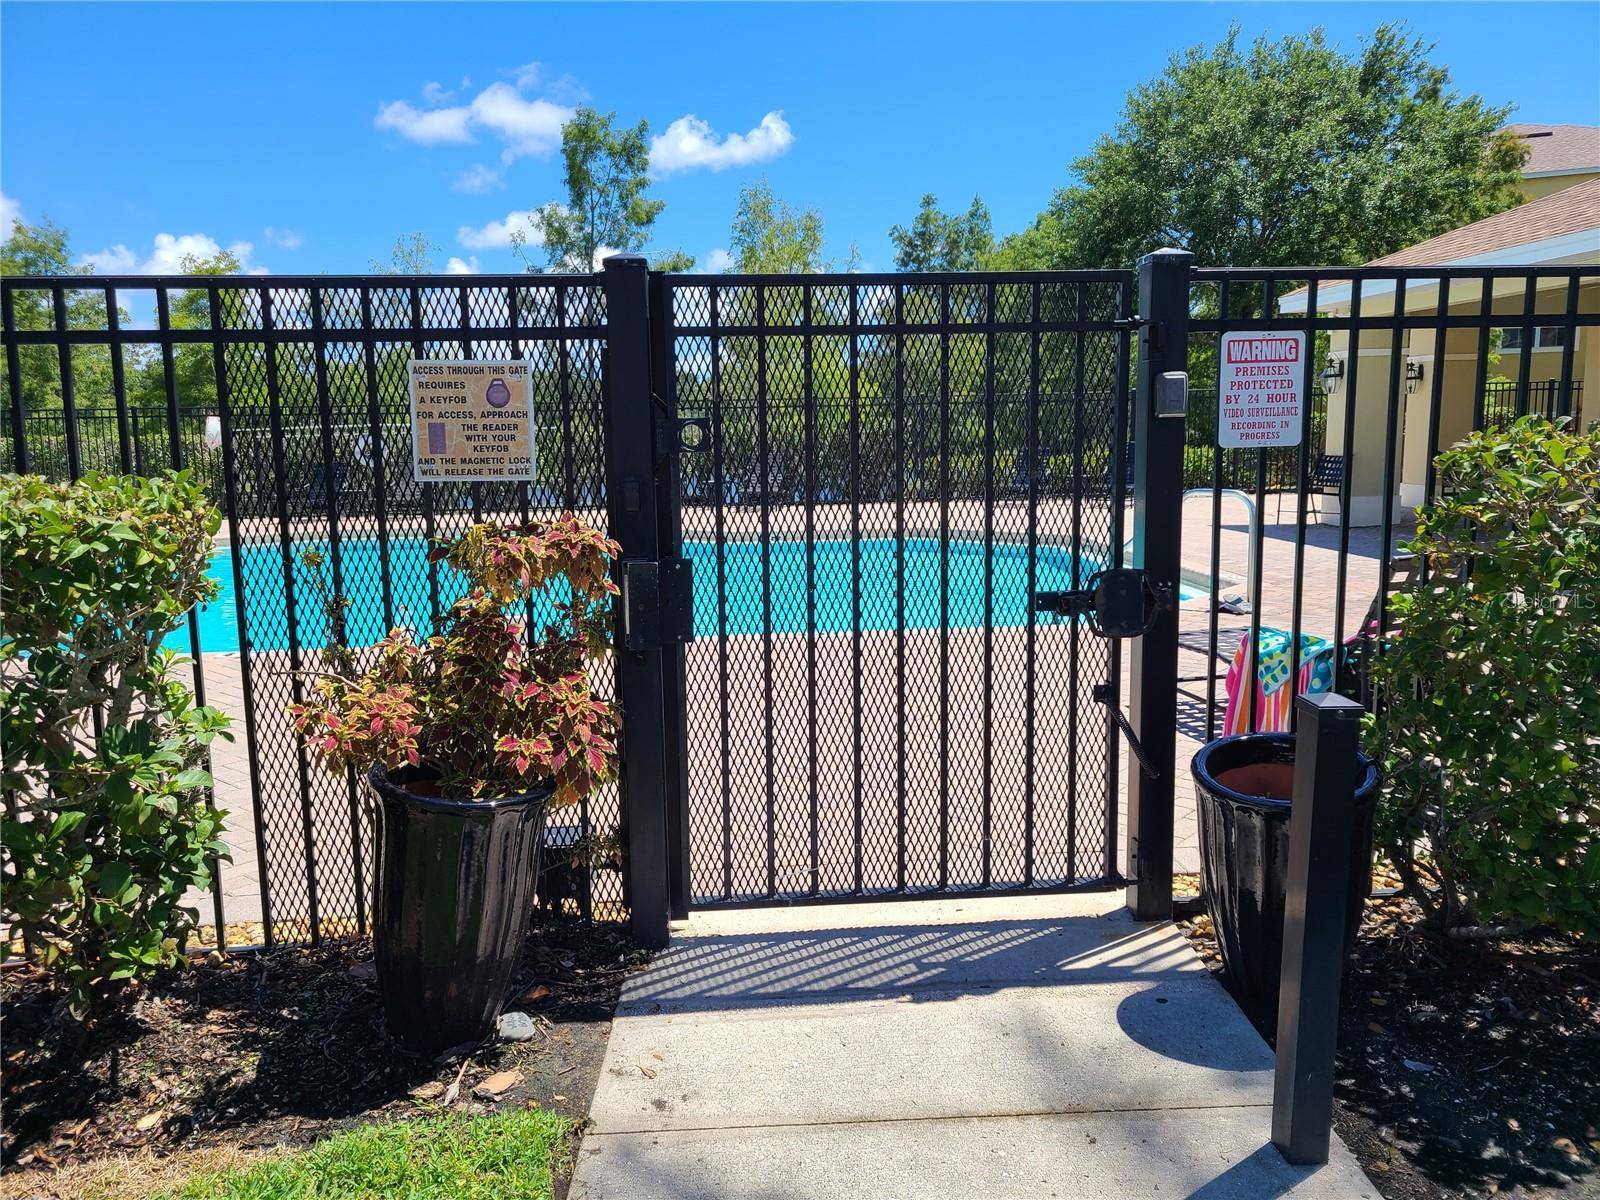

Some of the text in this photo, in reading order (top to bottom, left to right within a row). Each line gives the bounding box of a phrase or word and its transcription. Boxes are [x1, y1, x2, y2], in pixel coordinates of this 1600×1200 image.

[1230, 340, 1296, 361] WARNING
[413, 366, 528, 374] ACCESS THROUGH THIS GATE
[1235, 366, 1290, 376] PREMISES
[419, 381, 465, 389] REQUIRES
[1230, 380, 1293, 390] PROTECTED
[419, 396, 467, 404] A KEYFOB
[1225, 393, 1297, 404] BY 24 HOUR
[417, 411, 528, 419] FOR ACCESS, APPROACH
[1224, 407, 1298, 418] VIDEO SURVEILLANCE
[1232, 421, 1276, 430] RECORDING
[1240, 432, 1280, 440] PROGRESS
